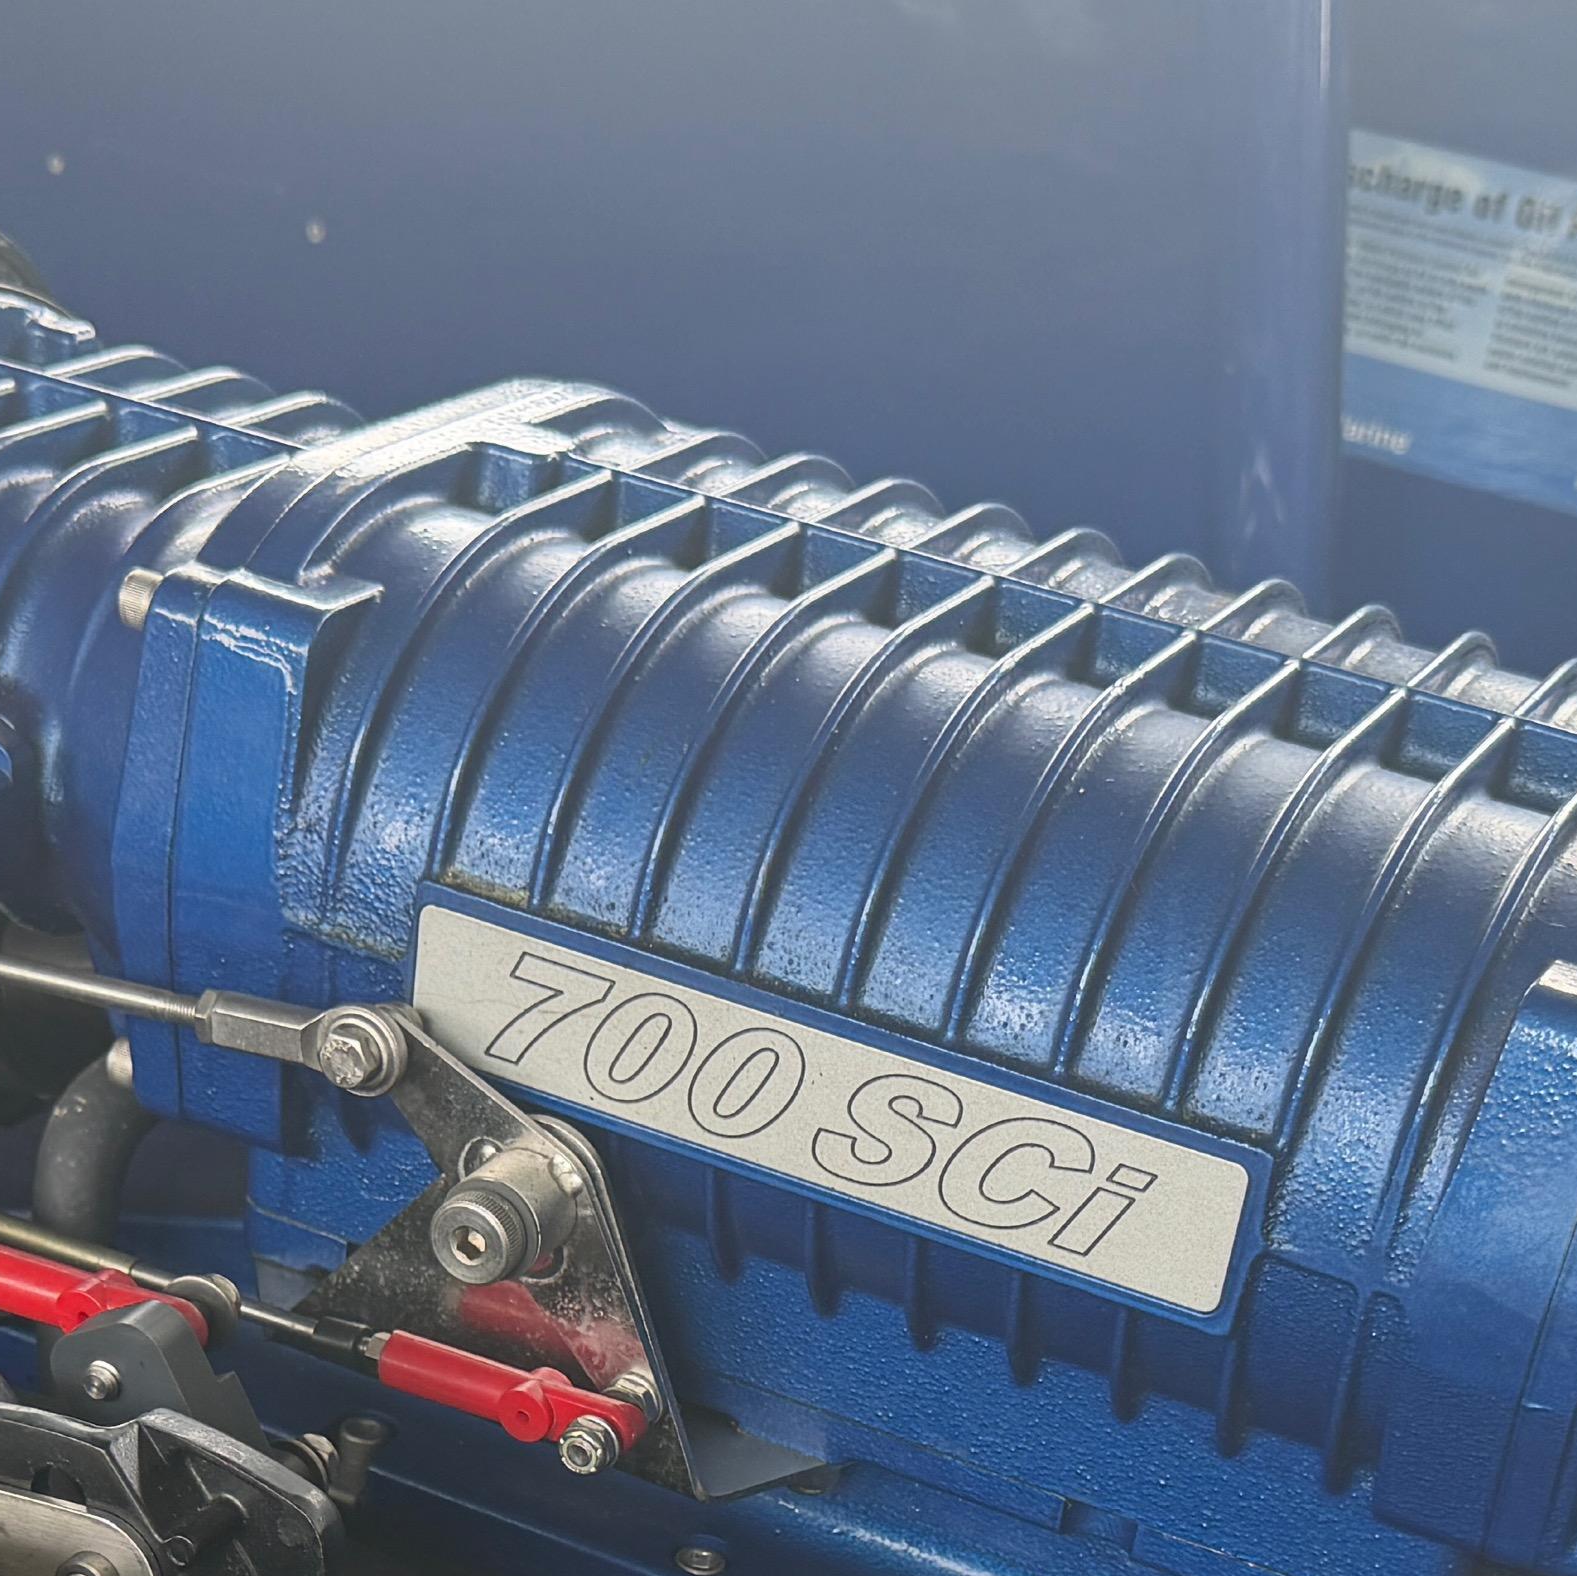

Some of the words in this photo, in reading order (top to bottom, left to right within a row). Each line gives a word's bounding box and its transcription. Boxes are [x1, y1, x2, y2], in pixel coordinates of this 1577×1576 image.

[1472, 190, 1507, 224] of
[484, 951, 806, 1139] 700
[811, 1073, 1158, 1258] SCi
